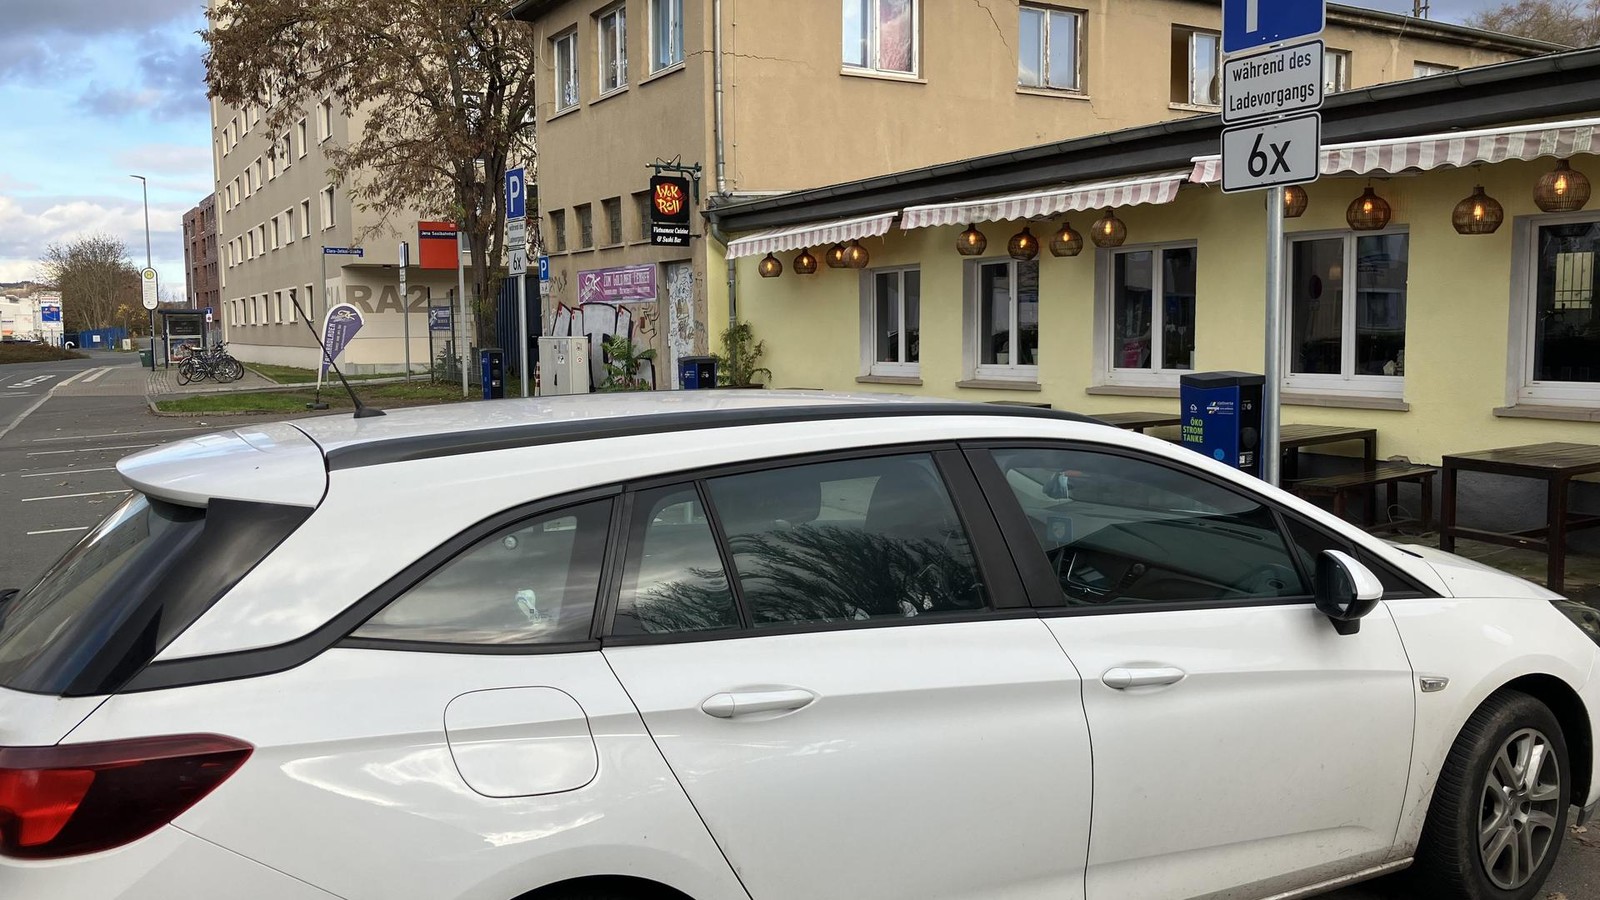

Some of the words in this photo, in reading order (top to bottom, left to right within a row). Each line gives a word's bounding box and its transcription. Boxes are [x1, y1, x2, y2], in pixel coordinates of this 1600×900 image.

[1233, 54, 1284, 82] während
[1289, 51, 1311, 70] des
[1230, 82, 1315, 112] Ladevorgangs
[1247, 132, 1291, 178] 6x
[509, 175, 520, 213] P
[540, 259, 547, 278] P
[1182, 426, 1203, 434] STROM
[1190, 417, 1203, 426] ÖKO
[1183, 434, 1203, 443] TANKE
